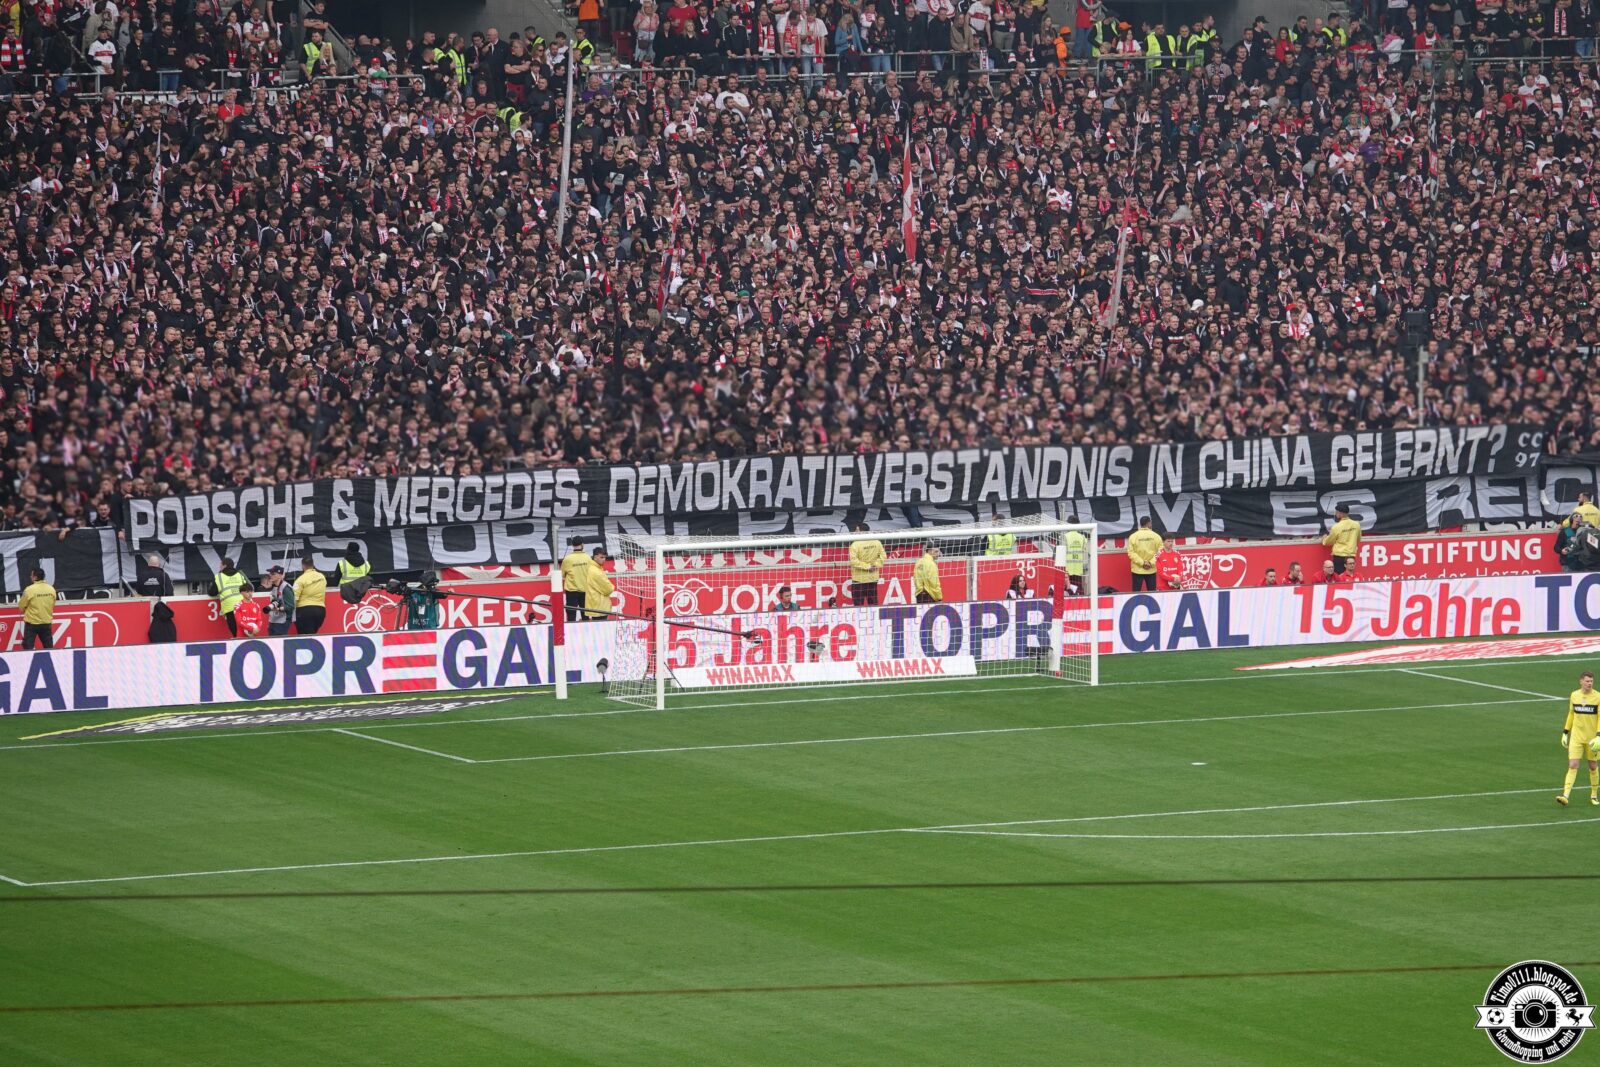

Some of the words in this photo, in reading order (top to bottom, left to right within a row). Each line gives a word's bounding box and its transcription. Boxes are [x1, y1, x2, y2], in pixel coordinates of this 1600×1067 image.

[1517, 431, 1543, 448] CC
[1514, 451, 1540, 468] 97
[130, 482, 314, 550] PORSCHE
[331, 478, 359, 532] &
[373, 468, 588, 527] MERCEDES:
[1146, 443, 1184, 497] IN
[1199, 434, 1316, 491] CHINA
[1330, 423, 1507, 485] GELERNT?
[1269, 489, 1377, 535] ES
[1425, 467, 1600, 530] REIC
[1358, 537, 1542, 568] fB-STIFTUNG
[1015, 560, 1036, 580] 35
[208, 601, 223, 621] 3
[1293, 582, 1354, 635] 15
[1371, 582, 1521, 638] Jahre
[714, 614, 858, 668] Jahre
[707, 665, 796, 685] WINAMAX
[856, 658, 945, 679] WINAMAX
